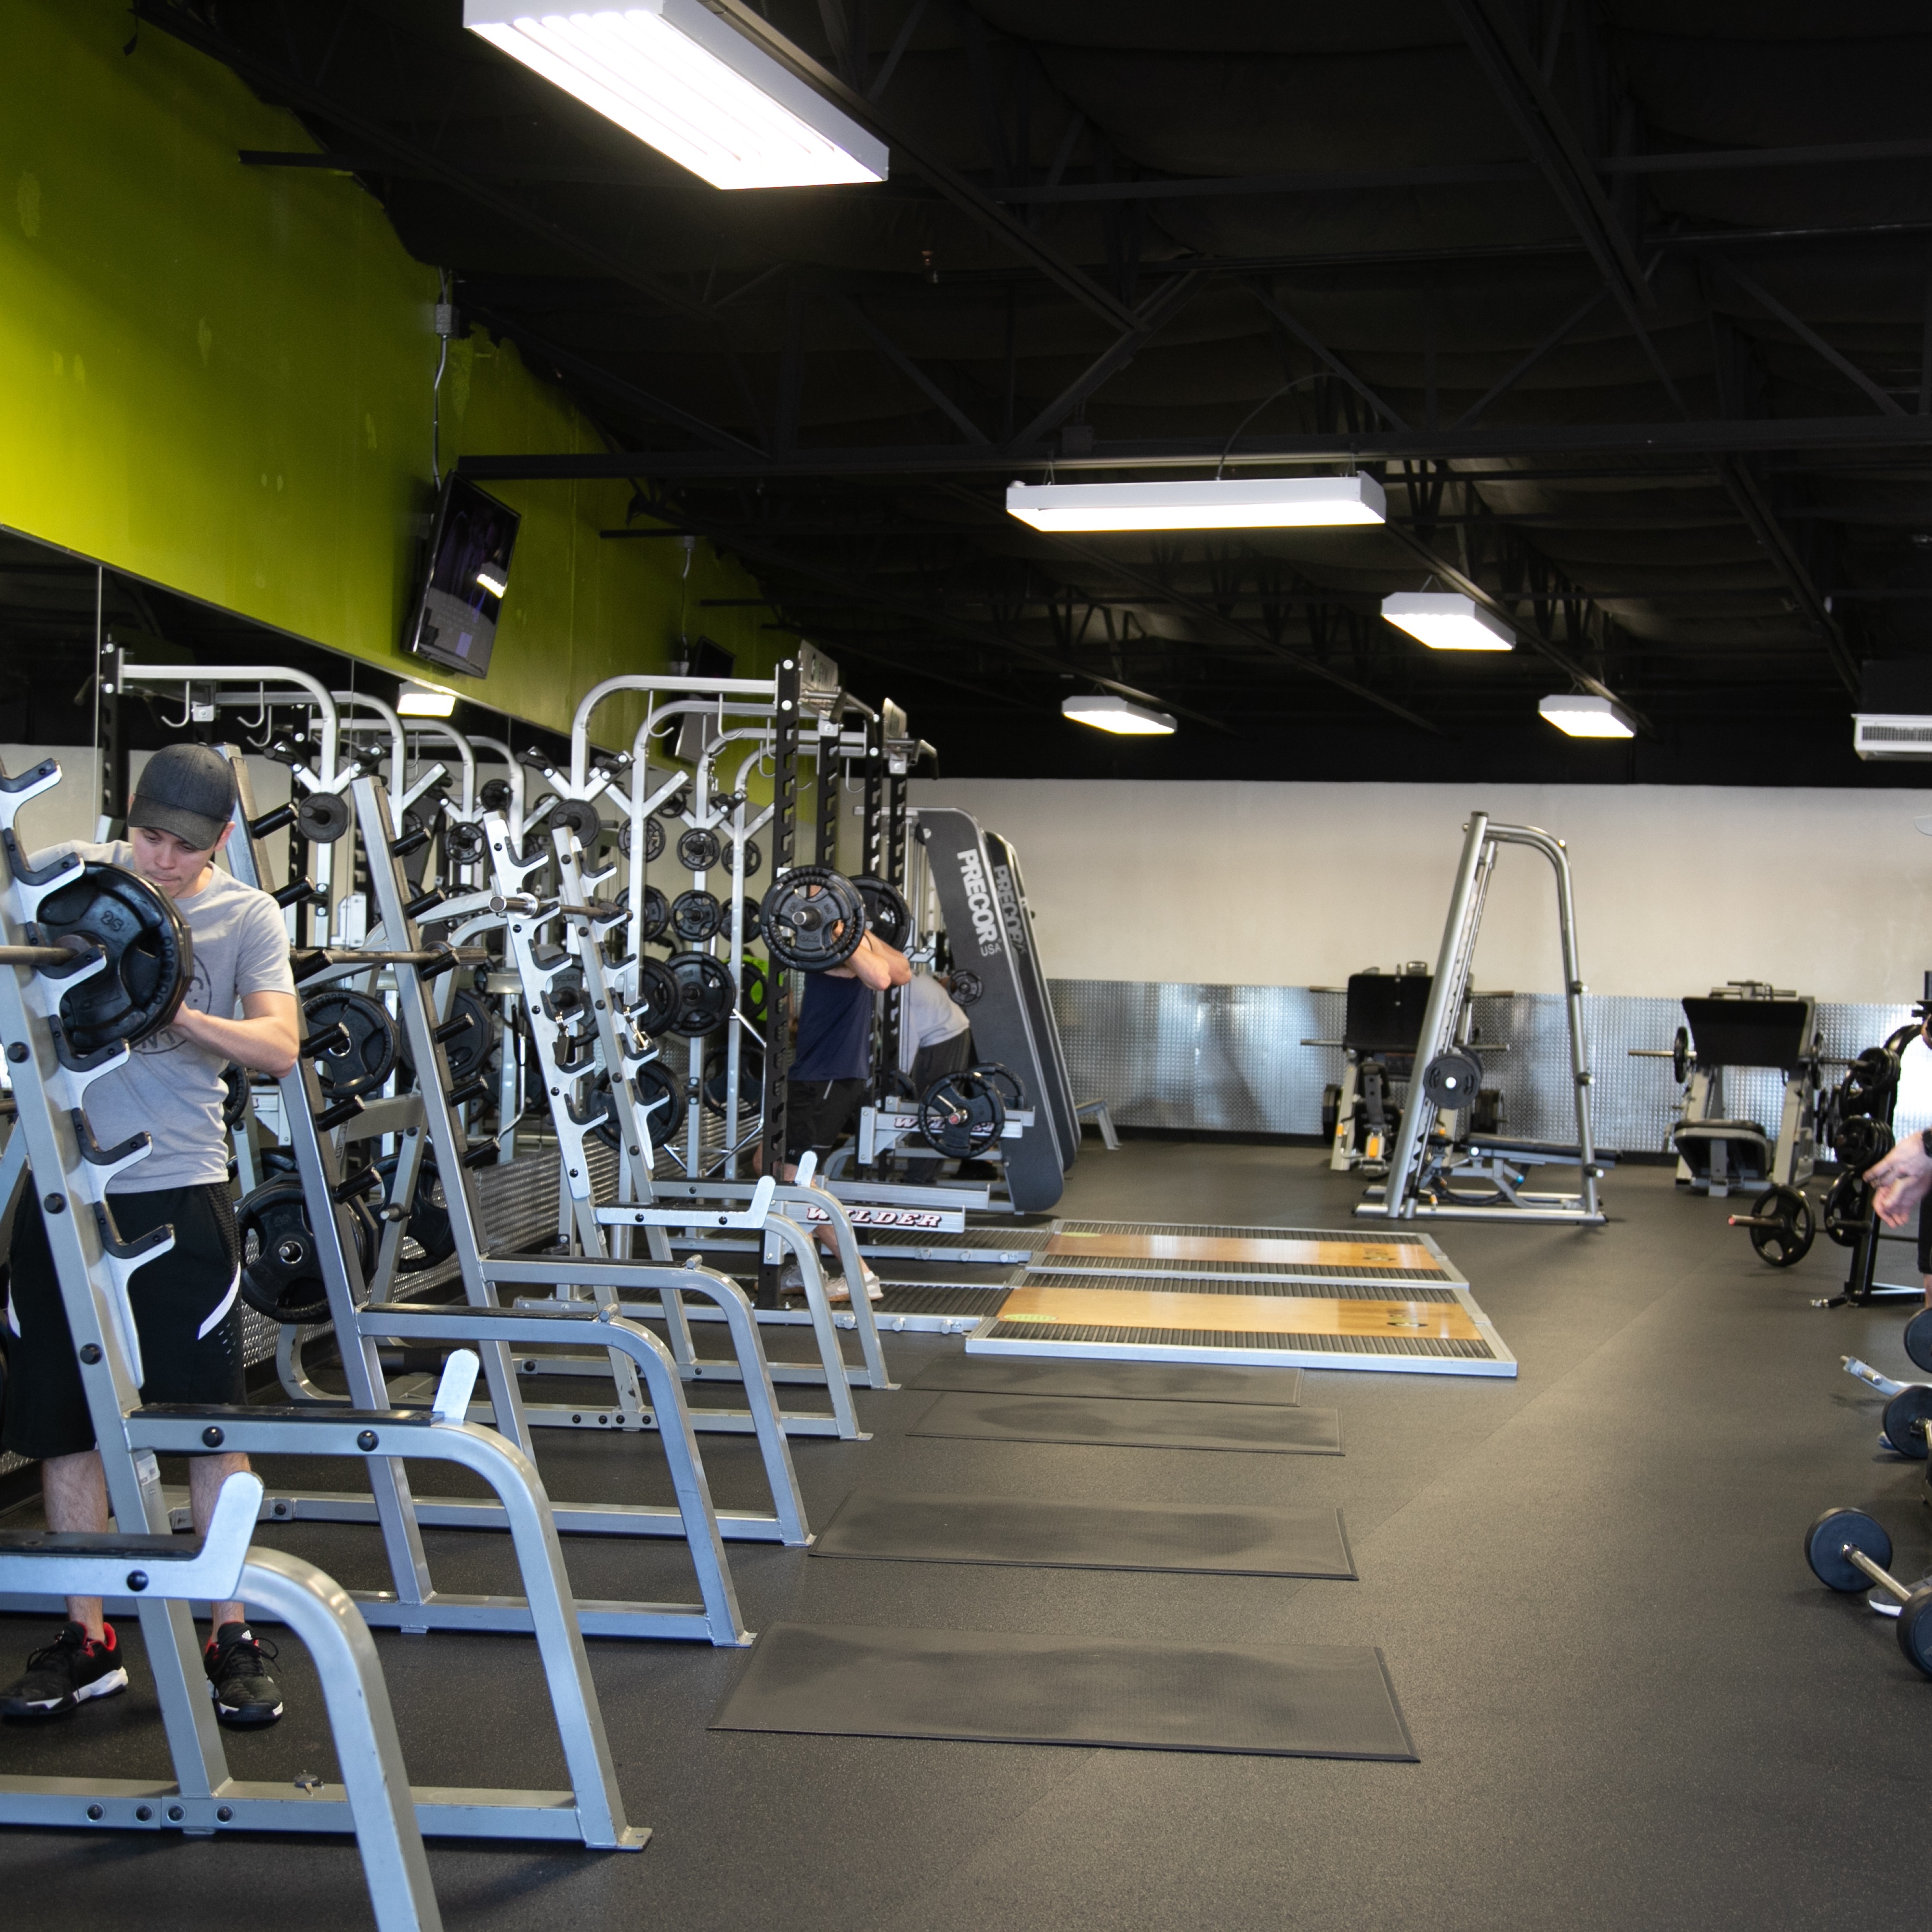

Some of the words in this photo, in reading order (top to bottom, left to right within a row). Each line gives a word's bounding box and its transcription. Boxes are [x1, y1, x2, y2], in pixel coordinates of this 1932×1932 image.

[957, 848, 998, 945] PRECOR
[993, 864, 1024, 944] PRECOR
[101, 910, 124, 931] 25
[980, 942, 1002, 957] USA
[807, 1207, 942, 1228] WLDER
